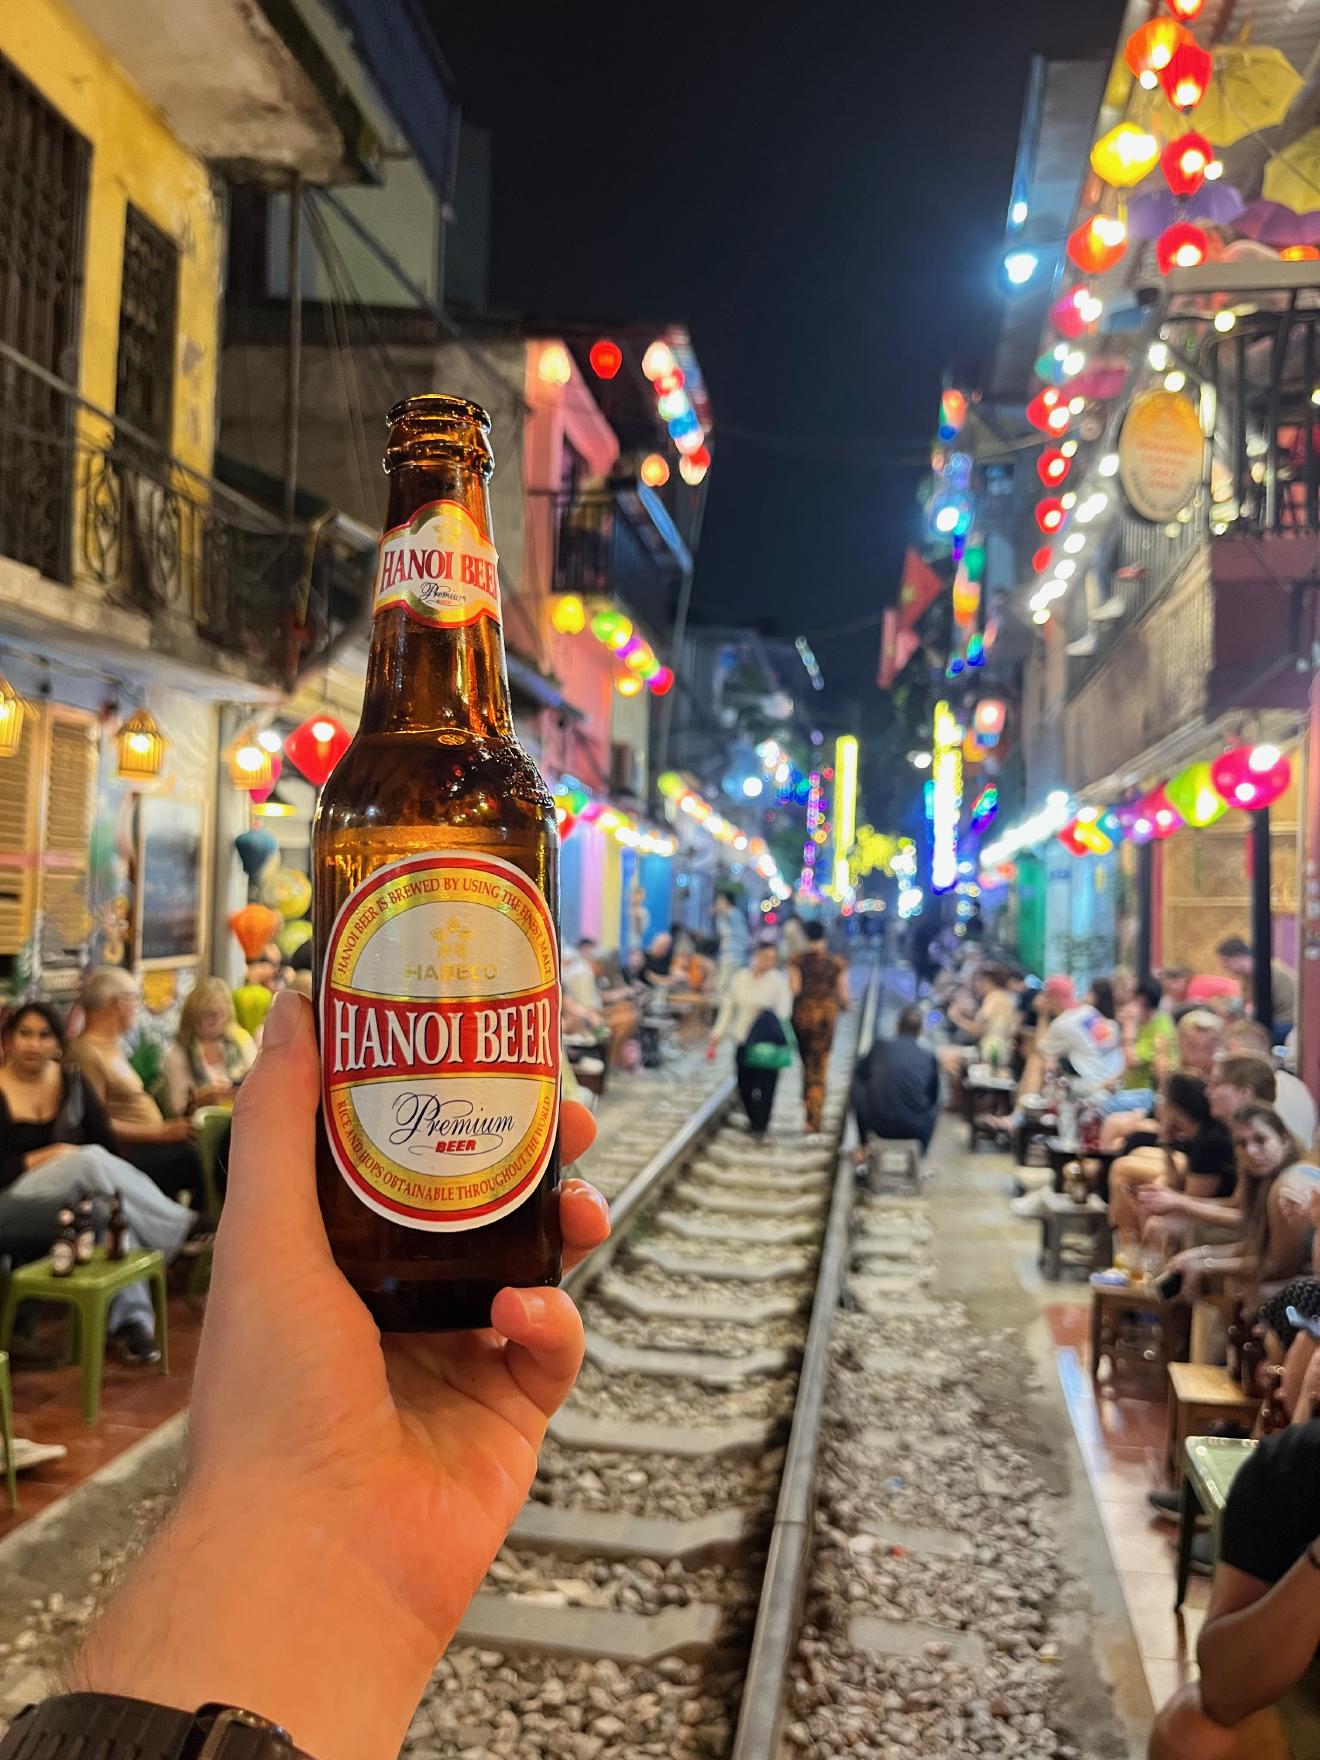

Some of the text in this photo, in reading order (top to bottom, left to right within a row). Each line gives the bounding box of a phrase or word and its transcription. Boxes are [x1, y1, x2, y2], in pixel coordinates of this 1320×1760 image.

[380, 548, 454, 593] HANOI
[420, 581, 466, 603] Premium
[338, 931, 359, 974] HANOI
[354, 906, 379, 934] BEER
[376, 896, 388, 912] IS
[388, 878, 440, 905] BREWED
[443, 877, 459, 891] BY
[462, 878, 500, 899] USING
[538, 940, 552, 975] MALT
[333, 997, 554, 1074] HANOI BEER
[389, 1091, 515, 1145] Premium
[337, 1100, 352, 1129] RICE
[345, 1130, 363, 1152] AND
[359, 1150, 385, 1177] HOPS
[383, 1171, 455, 1201] OBTAINABLE
[456, 1153, 527, 1200] THROUGHOUT
[524, 1137, 540, 1158] THE
[435, 1139, 477, 1153] BEER
